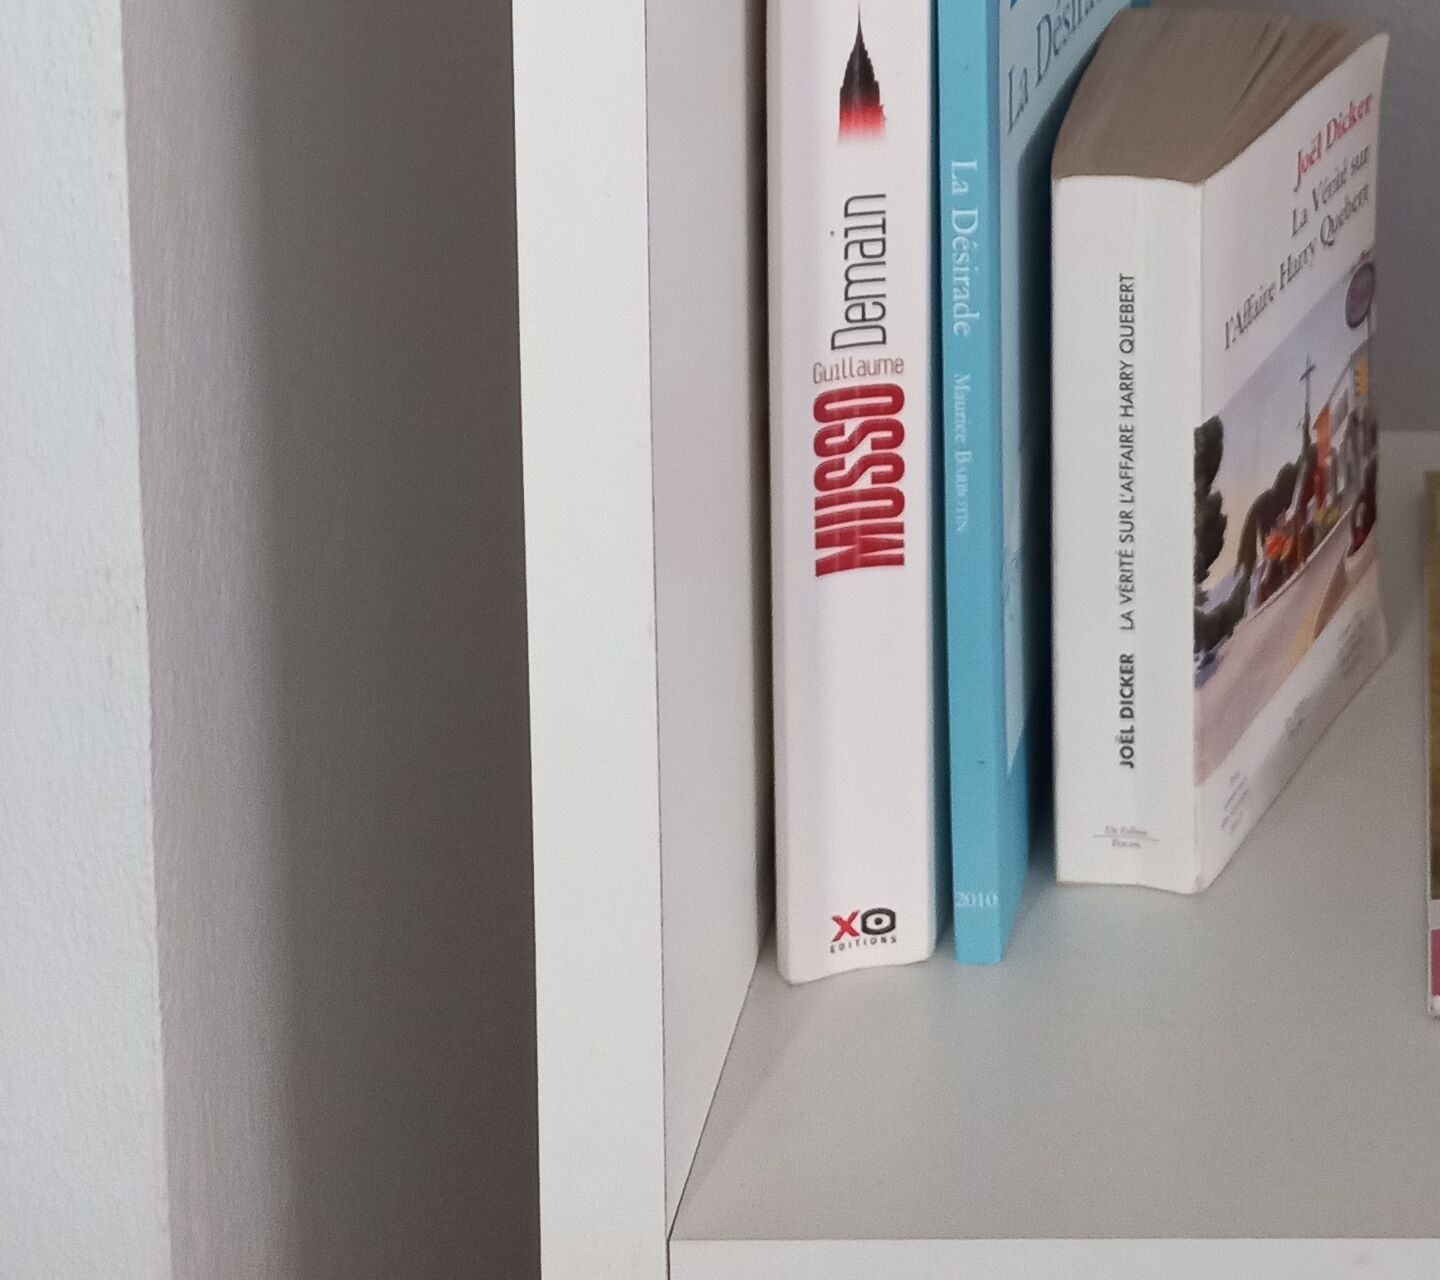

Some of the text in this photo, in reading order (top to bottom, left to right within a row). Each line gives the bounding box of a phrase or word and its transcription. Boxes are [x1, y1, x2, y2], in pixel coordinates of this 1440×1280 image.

[1006, 66, 1030, 133] La
[1326, 93, 1373, 152] Dicker
[829, 192, 887, 351] Demain
[951, 158, 980, 336] La Désirade
[812, 356, 905, 385] Guillaume
[953, 372, 972, 443] Maurice
[813, 383, 906, 577] MUSSO
[1114, 273, 1136, 631] LA VÉRITÉ SUR L'AFFAIRE HARRY QUEBERT
[1115, 654, 1135, 768] JOËL DICKER
[831, 907, 897, 942] XO
